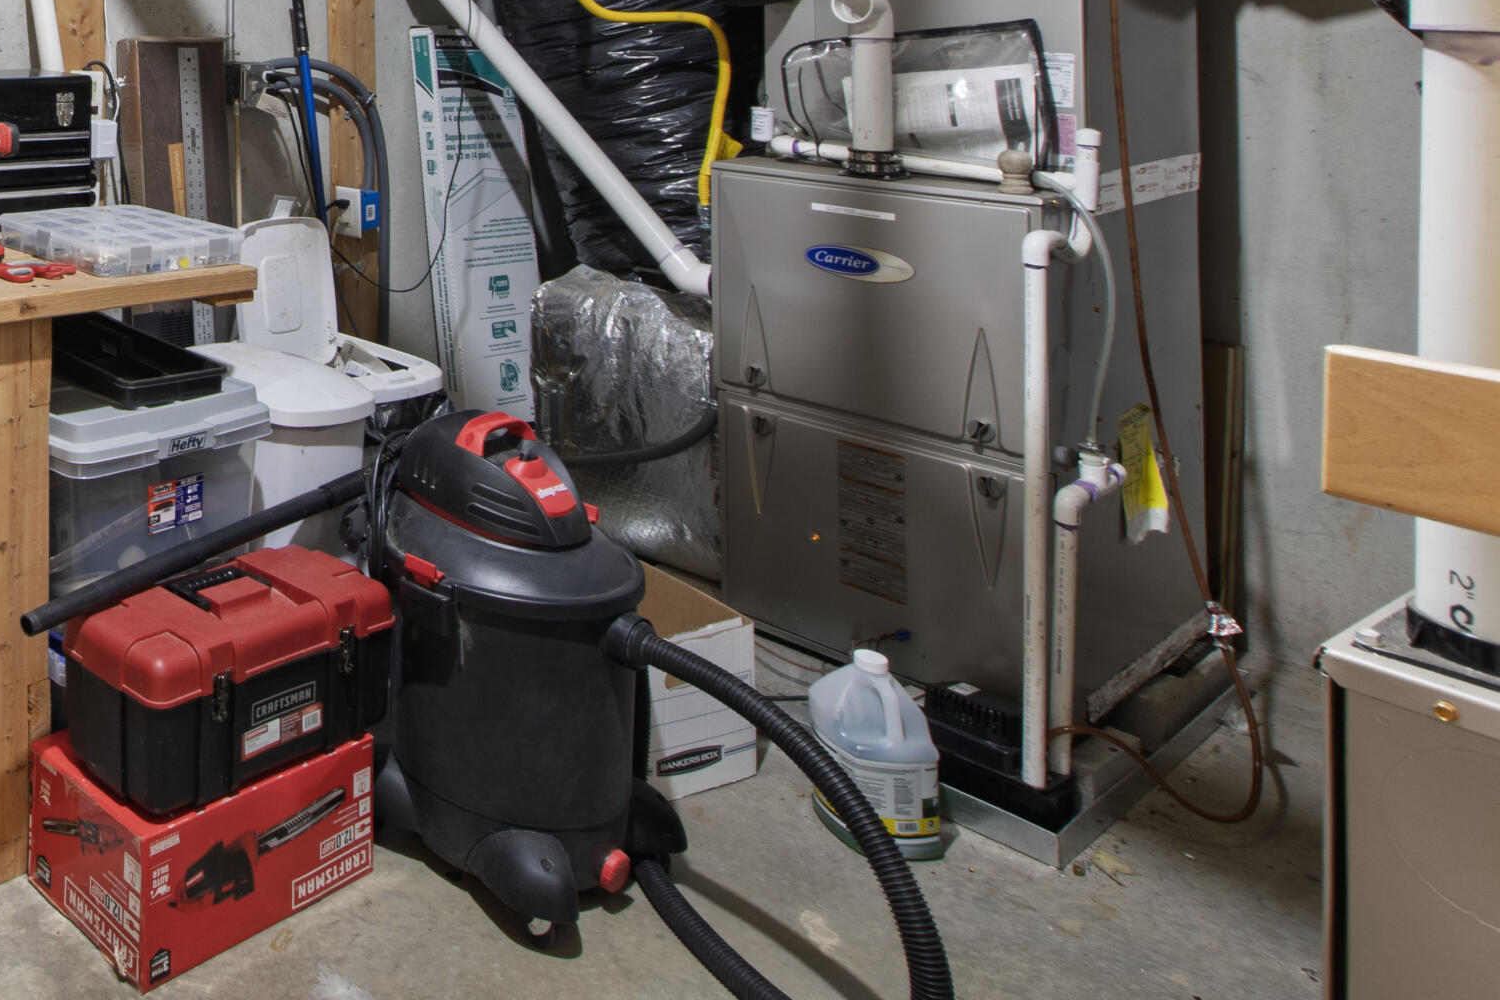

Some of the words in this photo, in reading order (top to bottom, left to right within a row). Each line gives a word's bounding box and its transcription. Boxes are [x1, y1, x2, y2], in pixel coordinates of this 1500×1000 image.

[814, 250, 872, 269] Carrier
[171, 434, 204, 454] Hefty
[255, 687, 313, 719] CRAFTSMAN
[660, 755, 700, 772] BANKERS
[701, 750, 719, 761] BOX
[321, 837, 336, 857] AMP
[335, 829, 353, 850] 12.0
[152, 863, 170, 877] OILER
[152, 873, 170, 887] AUTO
[297, 848, 367, 899] CRAFTSMAN
[104, 895, 122, 922] 12.0
[68, 889, 134, 970] CRAFTSMAN
